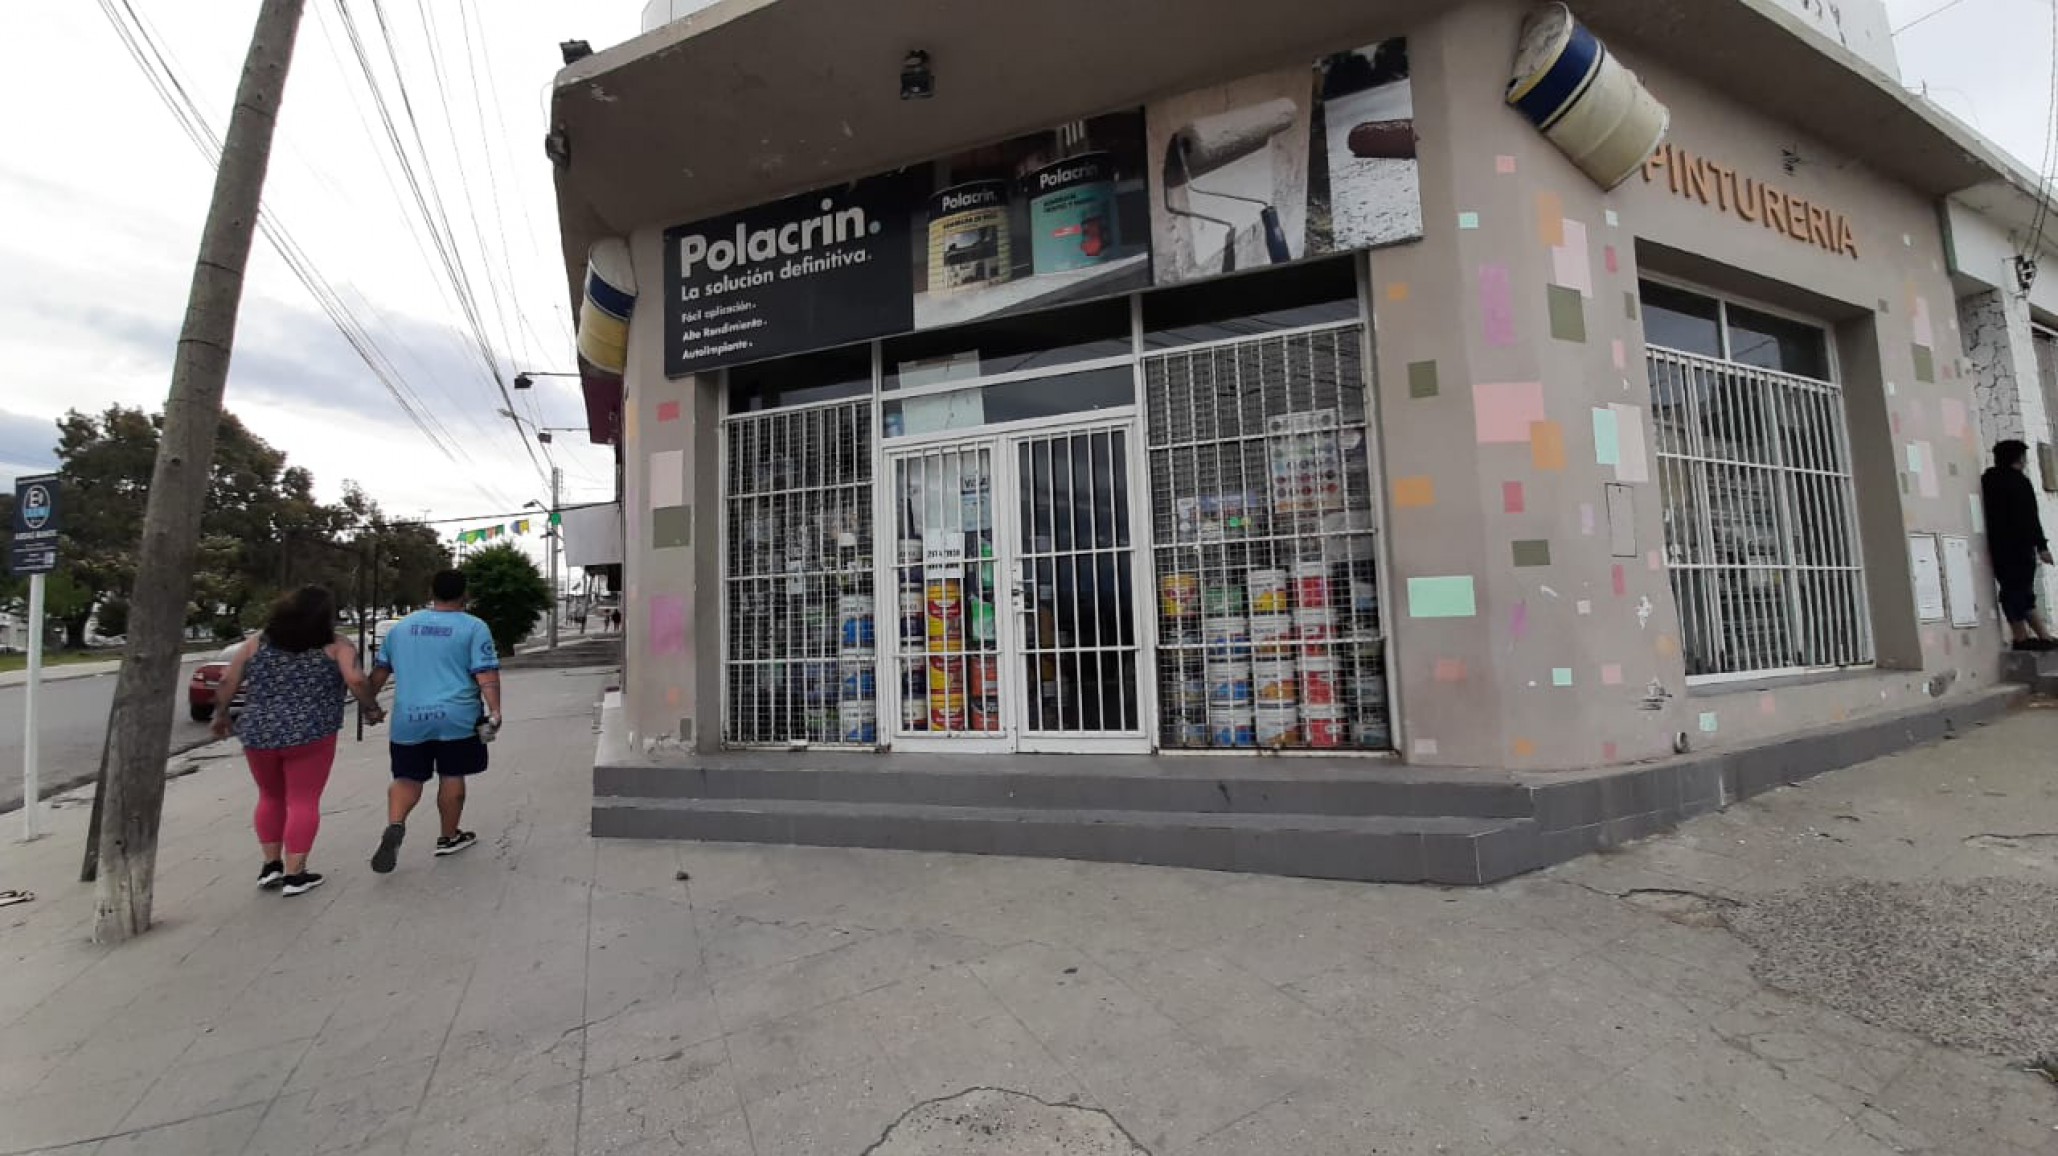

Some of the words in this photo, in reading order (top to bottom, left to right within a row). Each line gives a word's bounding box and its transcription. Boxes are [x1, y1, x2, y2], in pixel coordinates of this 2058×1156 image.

[1642, 143, 1858, 260] PINTURERIA
[681, 285, 700, 301] La
[705, 267, 774, 297] solución
[779, 249, 872, 280] definitiva.
